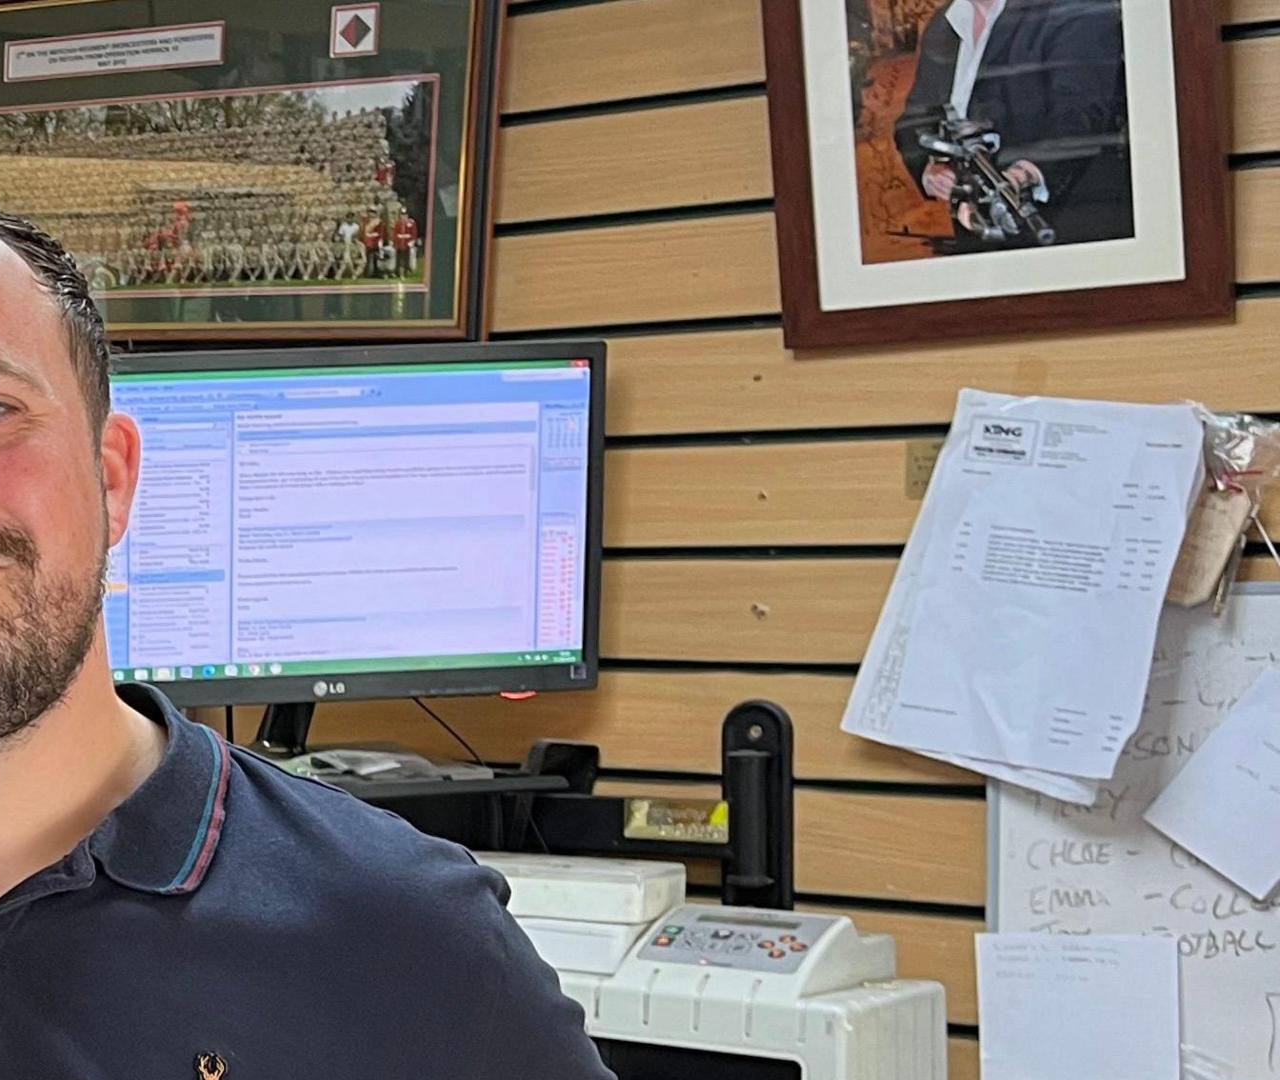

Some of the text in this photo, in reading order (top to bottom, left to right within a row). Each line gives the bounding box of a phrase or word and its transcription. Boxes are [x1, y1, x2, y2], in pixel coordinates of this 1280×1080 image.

[329, 682, 346, 694] LG
[1026, 839, 1112, 870] CHLOE
[1029, 885, 1111, 915] EMMA
